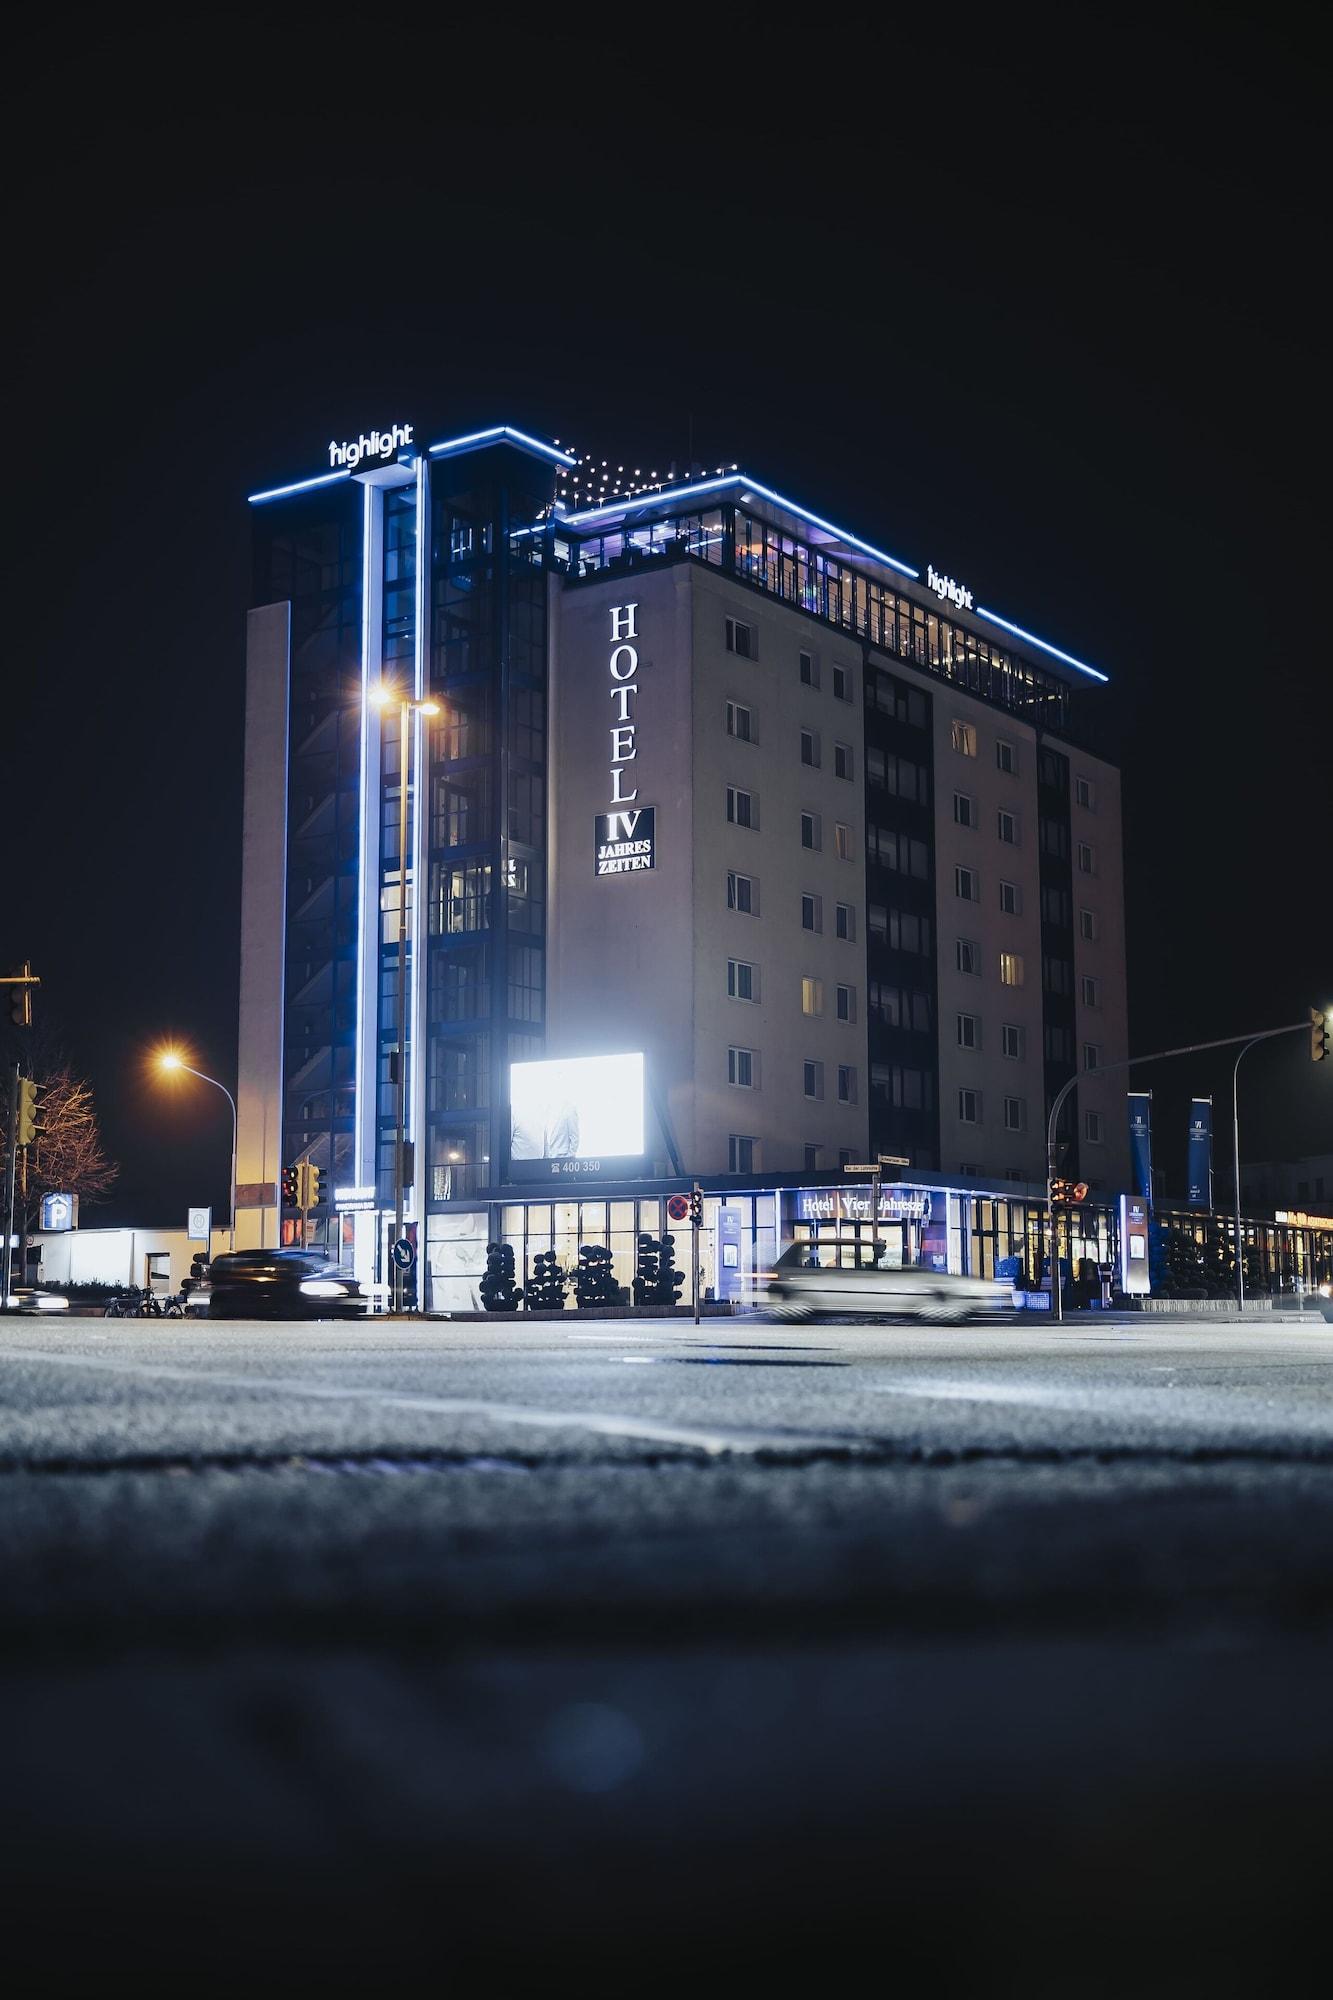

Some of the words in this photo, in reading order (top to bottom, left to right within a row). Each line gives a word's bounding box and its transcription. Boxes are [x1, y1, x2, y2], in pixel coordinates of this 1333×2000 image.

[328, 424, 413, 468] highlight
[927, 564, 973, 609] highlight
[609, 603, 638, 803] HOTEL
[606, 809, 642, 841] IV
[598, 840, 651, 859] JAHRES
[598, 855, 651, 874] ZEITEN
[562, 1161, 580, 1172] 400
[582, 1161, 600, 1171] 350
[51, 1203, 67, 1227] P
[803, 1197, 834, 1212] Hotel
[842, 1197, 871, 1211] Vier
[877, 1197, 932, 1212] Jahreszei
